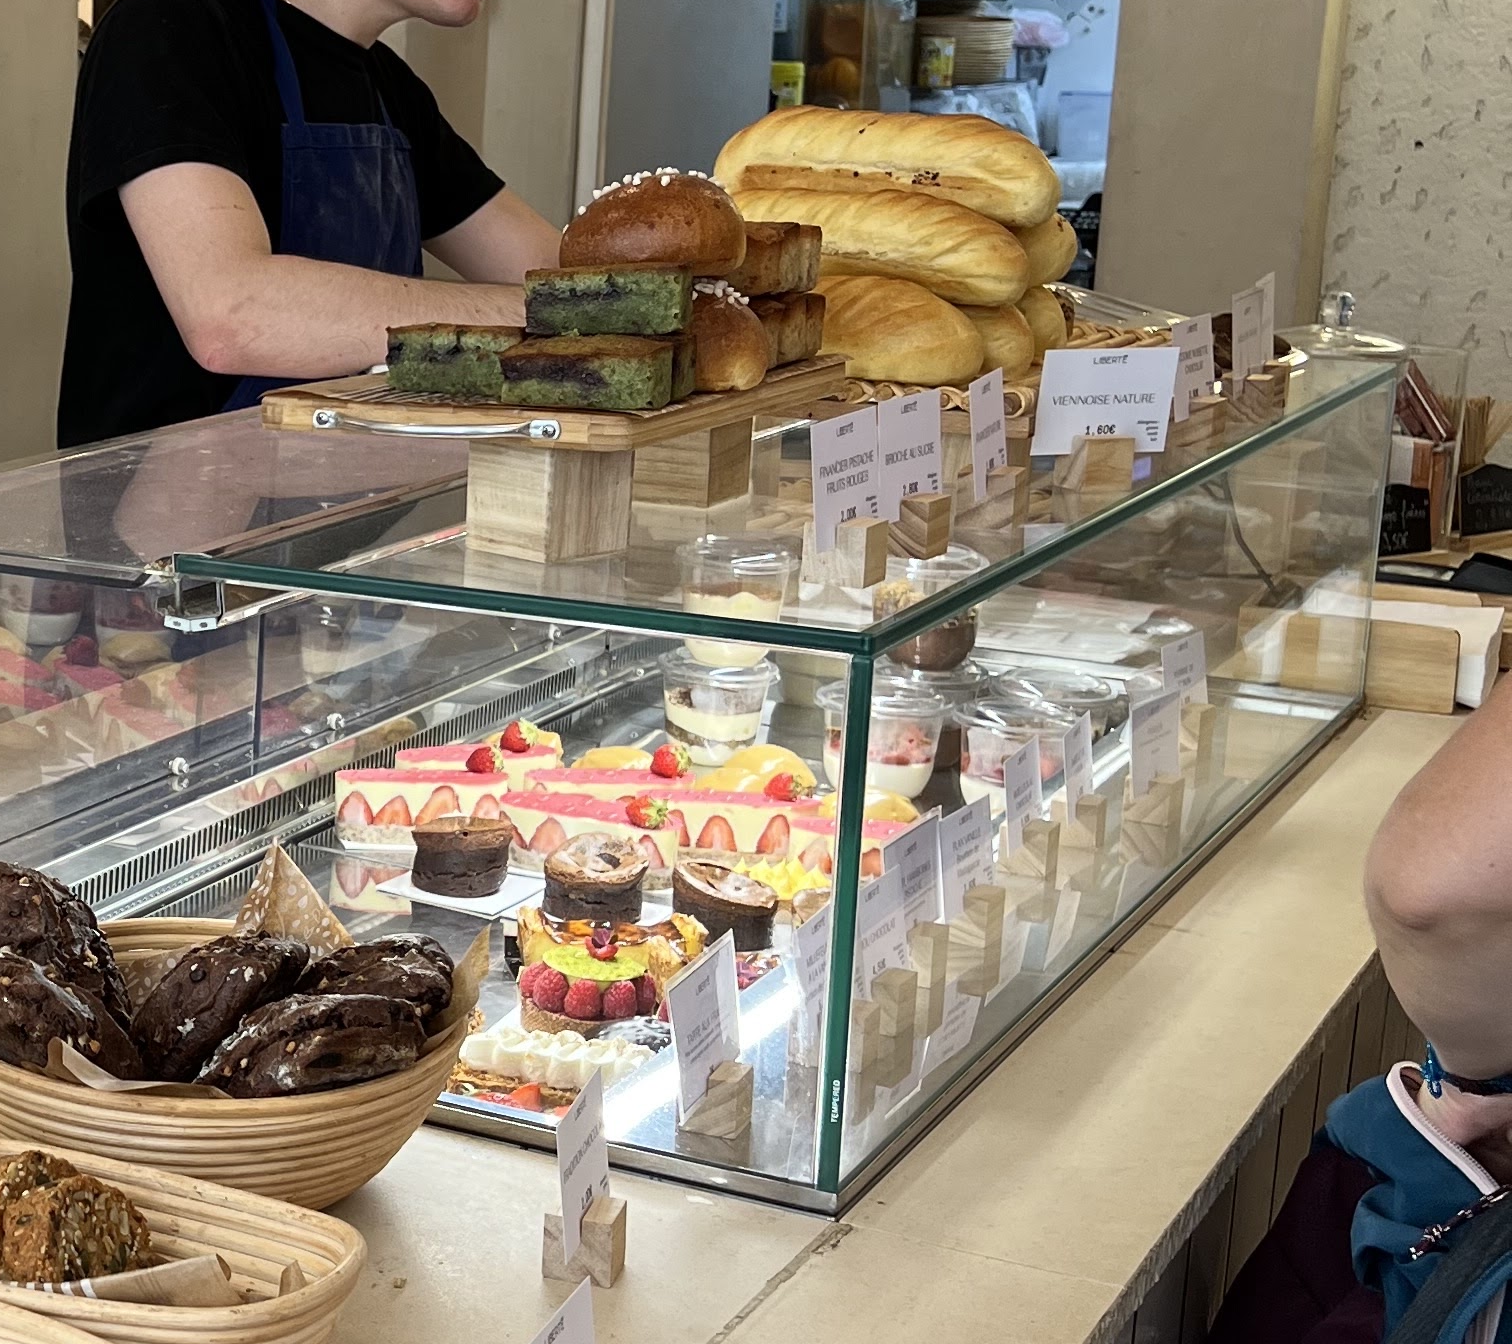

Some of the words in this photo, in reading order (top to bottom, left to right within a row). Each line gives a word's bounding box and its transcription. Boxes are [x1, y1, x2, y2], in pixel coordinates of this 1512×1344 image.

[1052, 394, 1110, 406] VIENNOISE
[1113, 392, 1156, 405] NATURE
[819, 457, 848, 479] FINANCIER
[848, 449, 875, 471] PISTACHE
[885, 447, 908, 466] BRIOCHE
[918, 442, 935, 458] SUCRE
[826, 477, 845, 495] FRUITS
[845, 469, 870, 489] ROUGES
[830, 1079, 841, 1124] TEMPERED
